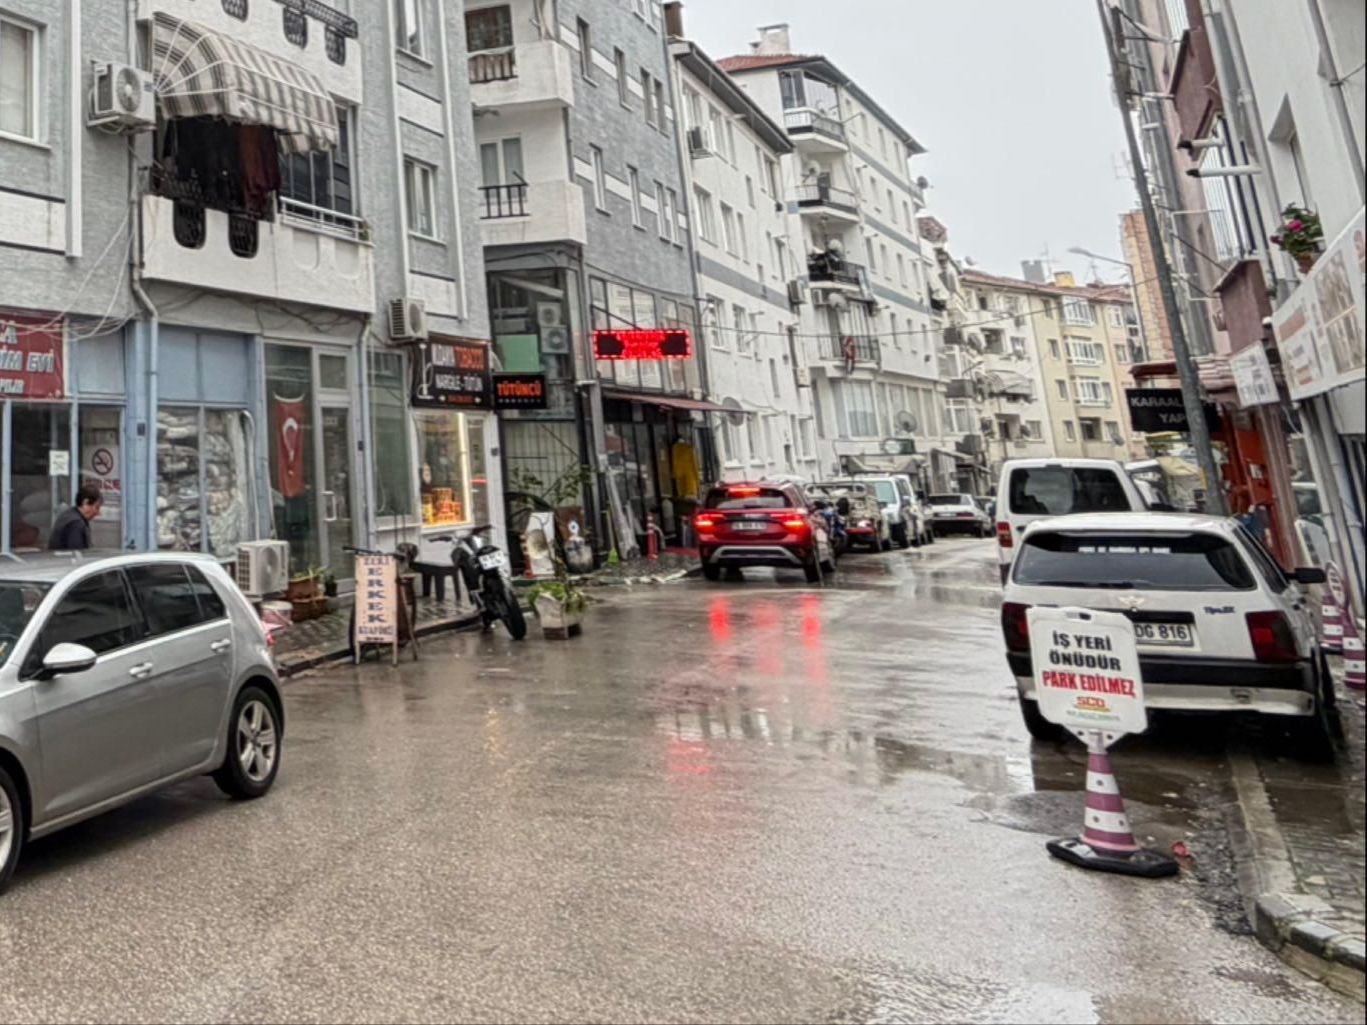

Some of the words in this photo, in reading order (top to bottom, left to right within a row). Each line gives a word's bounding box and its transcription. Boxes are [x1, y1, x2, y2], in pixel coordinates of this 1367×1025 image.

[26, 349, 54, 372] EVİ
[496, 380, 542, 396] TÜTÜNCÜ
[1052, 629, 1070, 649] İŞ
[1074, 633, 1113, 652] YERİ
[1157, 625, 1187, 640] 816
[1048, 648, 1122, 672] ÖNÜDÜR
[1041, 670, 1079, 691] PARK
[1080, 672, 1137, 699] EDİLMEZ
